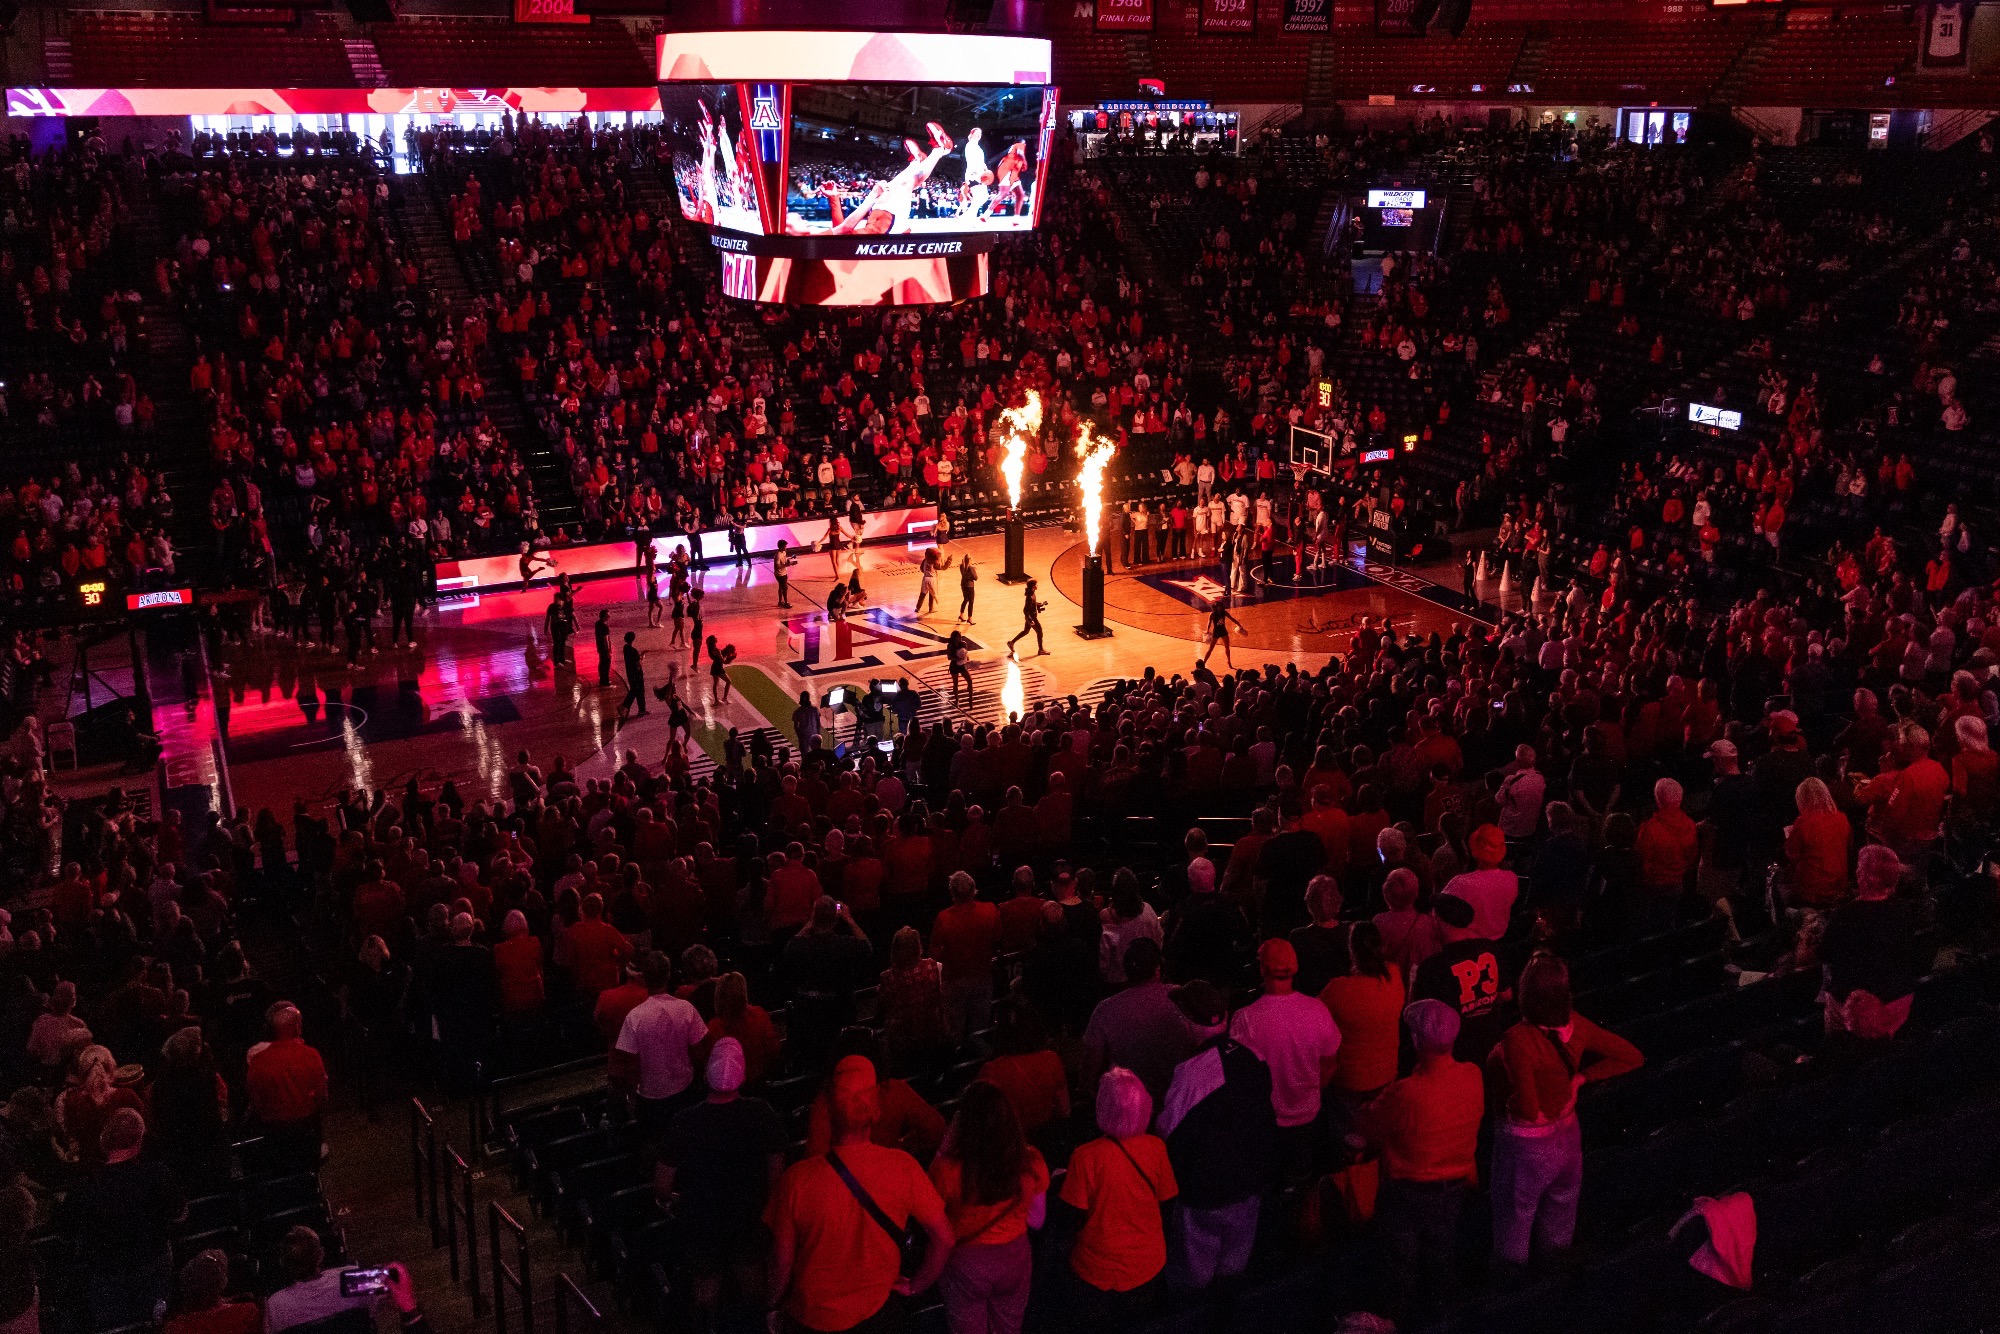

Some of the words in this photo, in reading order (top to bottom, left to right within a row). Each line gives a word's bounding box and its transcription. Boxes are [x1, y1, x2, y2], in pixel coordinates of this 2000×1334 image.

[1214, 0, 1246, 12] 1994
[1294, 0, 1324, 13] 1997
[1128, 15, 1151, 23] FOUR
[1290, 15, 1327, 23] NATIONAL
[1284, 23, 1329, 31] CHAMPIONS
[1940, 23, 1953, 37] 31
[720, 237, 748, 251] CENTER
[855, 243, 916, 256] MCKALE
[917, 241, 962, 255] CENTER
[1405, 442, 1415, 451] 30
[84, 592, 101, 605] 30
[139, 592, 182, 606] ARIZONA
